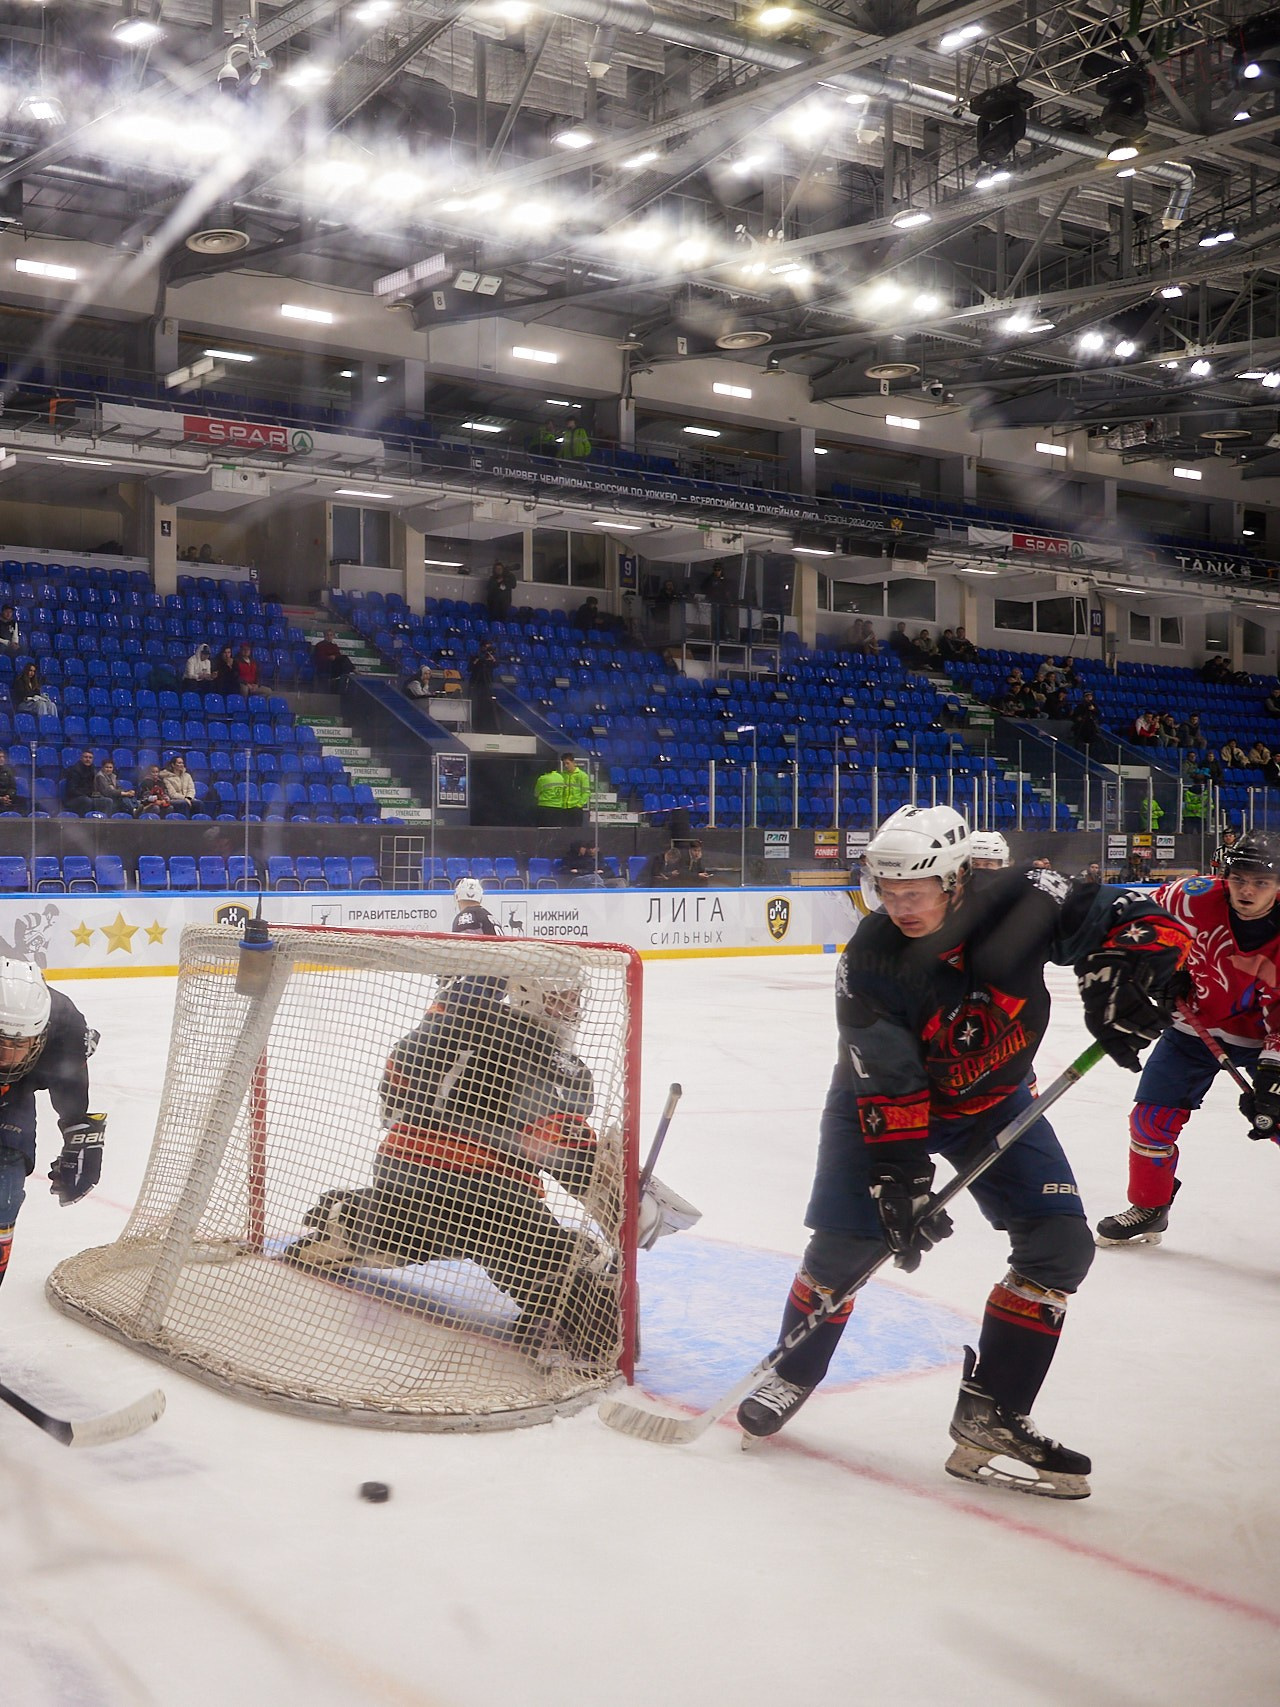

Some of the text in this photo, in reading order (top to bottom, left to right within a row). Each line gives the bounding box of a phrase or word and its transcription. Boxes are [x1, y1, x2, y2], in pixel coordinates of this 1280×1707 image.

[436, 296, 443, 305] 8
[208, 423, 287, 448] SPAR
[540, 473, 593, 489] ЧЕМПИОНАТ
[1025, 538, 1069, 554] SPAR
[624, 560, 632, 576] 9
[1175, 556, 1237, 577] TANK
[1092, 612, 1102, 625] 10
[374, 788, 400, 796] SYNERGETIC
[814, 848, 838, 856] FONBET
[348, 909, 438, 921] ПРАВИТЕЛЬСТВО
[533, 907, 579, 921] НИЖНИЙ
[646, 897, 725, 924] ЛИГА
[533, 925, 588, 938] НОВГОРОД
[650, 931, 723, 945] СИЛЬНЫХ
